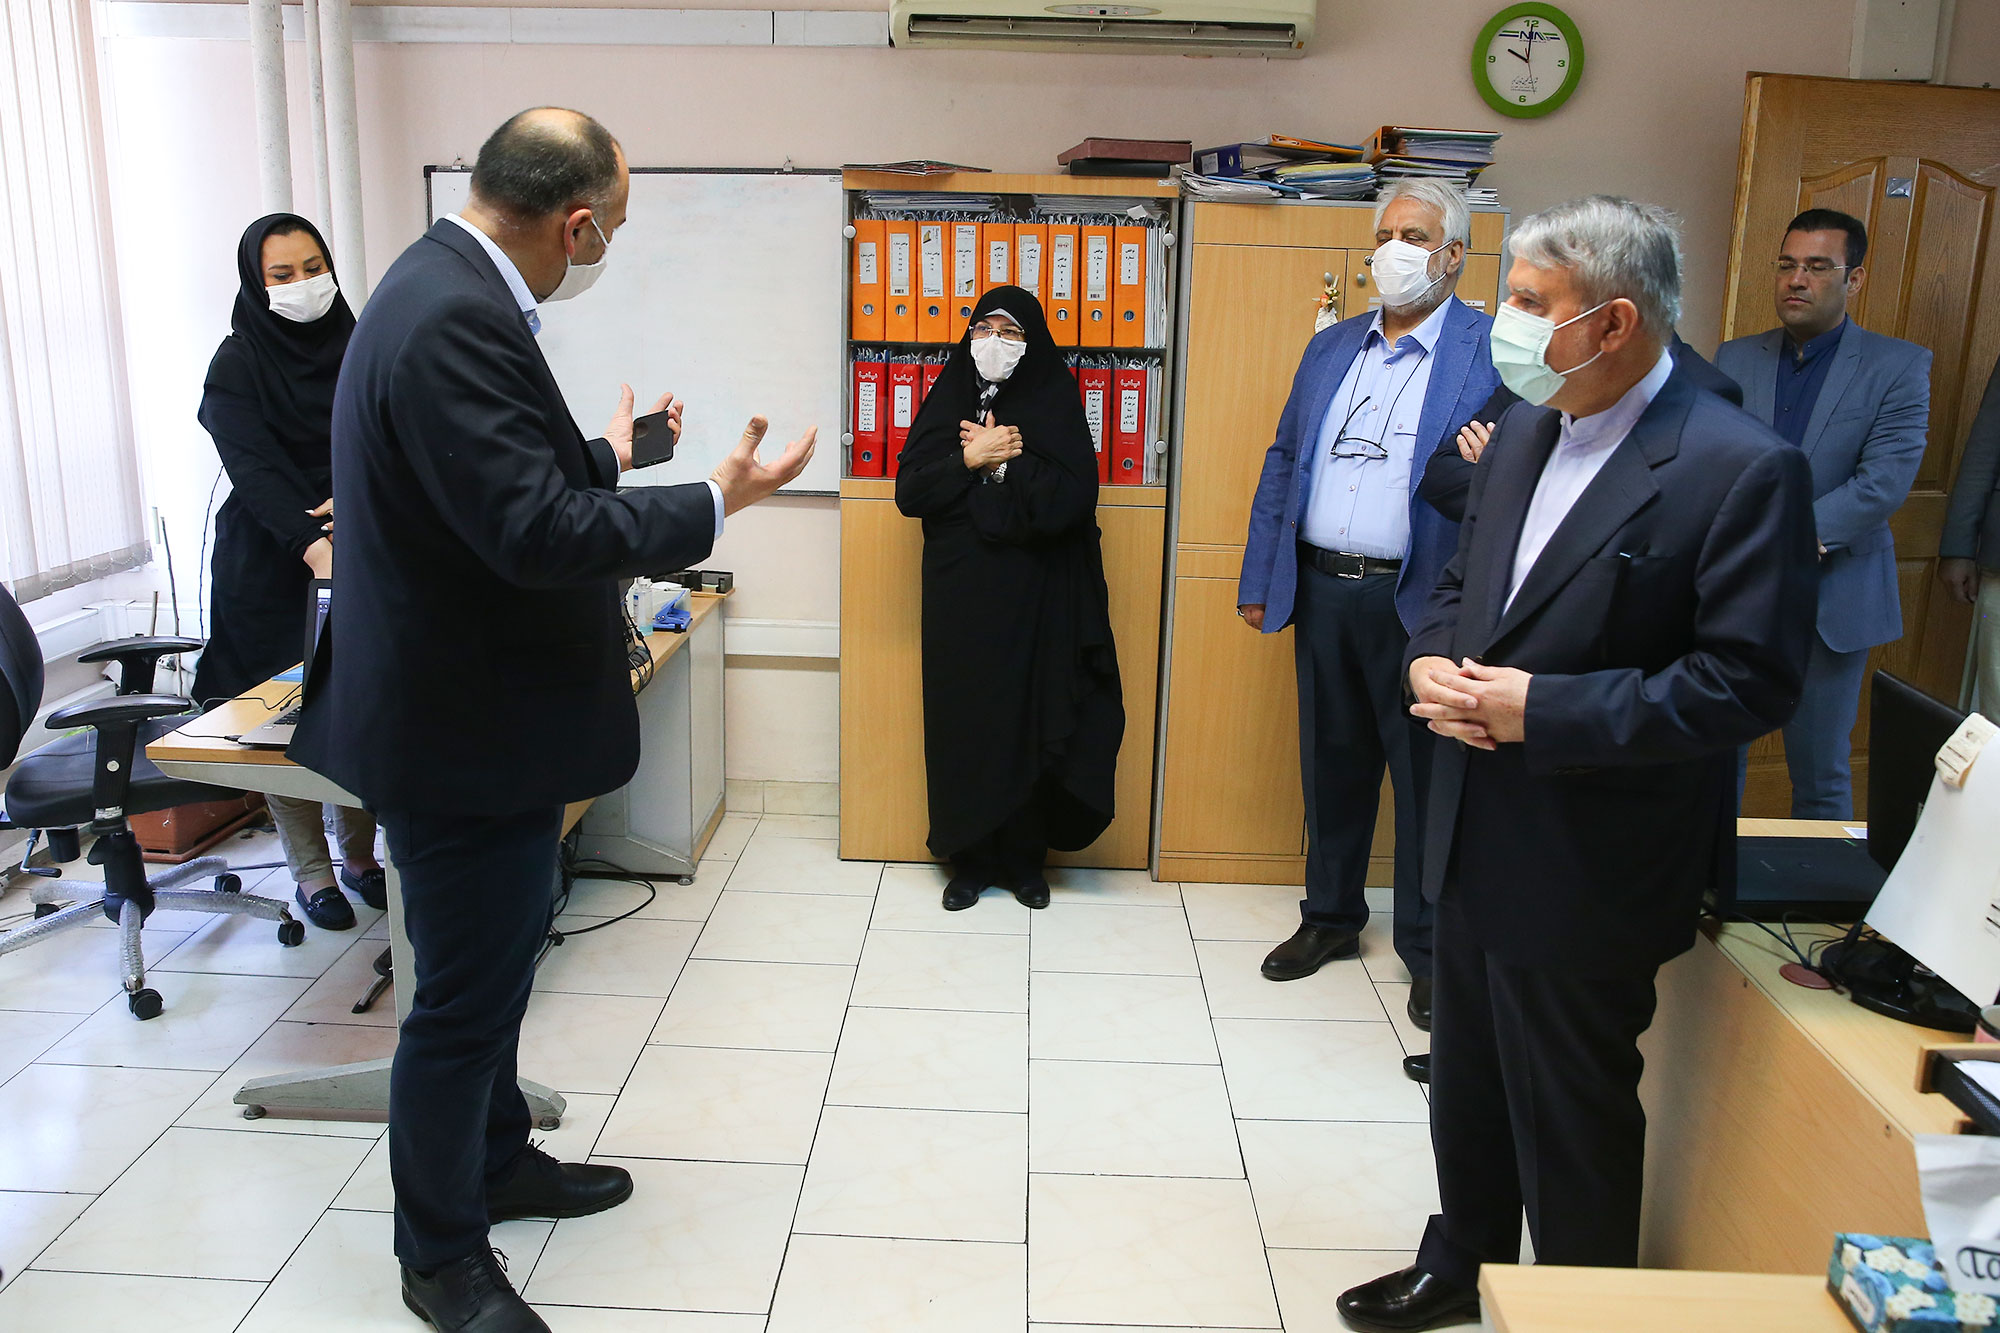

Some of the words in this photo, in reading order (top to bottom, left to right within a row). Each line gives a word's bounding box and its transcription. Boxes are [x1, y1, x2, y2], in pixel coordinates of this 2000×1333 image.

[1524, 20, 1540, 28] 12
[1488, 56, 1496, 64] 9
[1557, 60, 1566, 68] 3
[1518, 95, 1526, 103] 6
